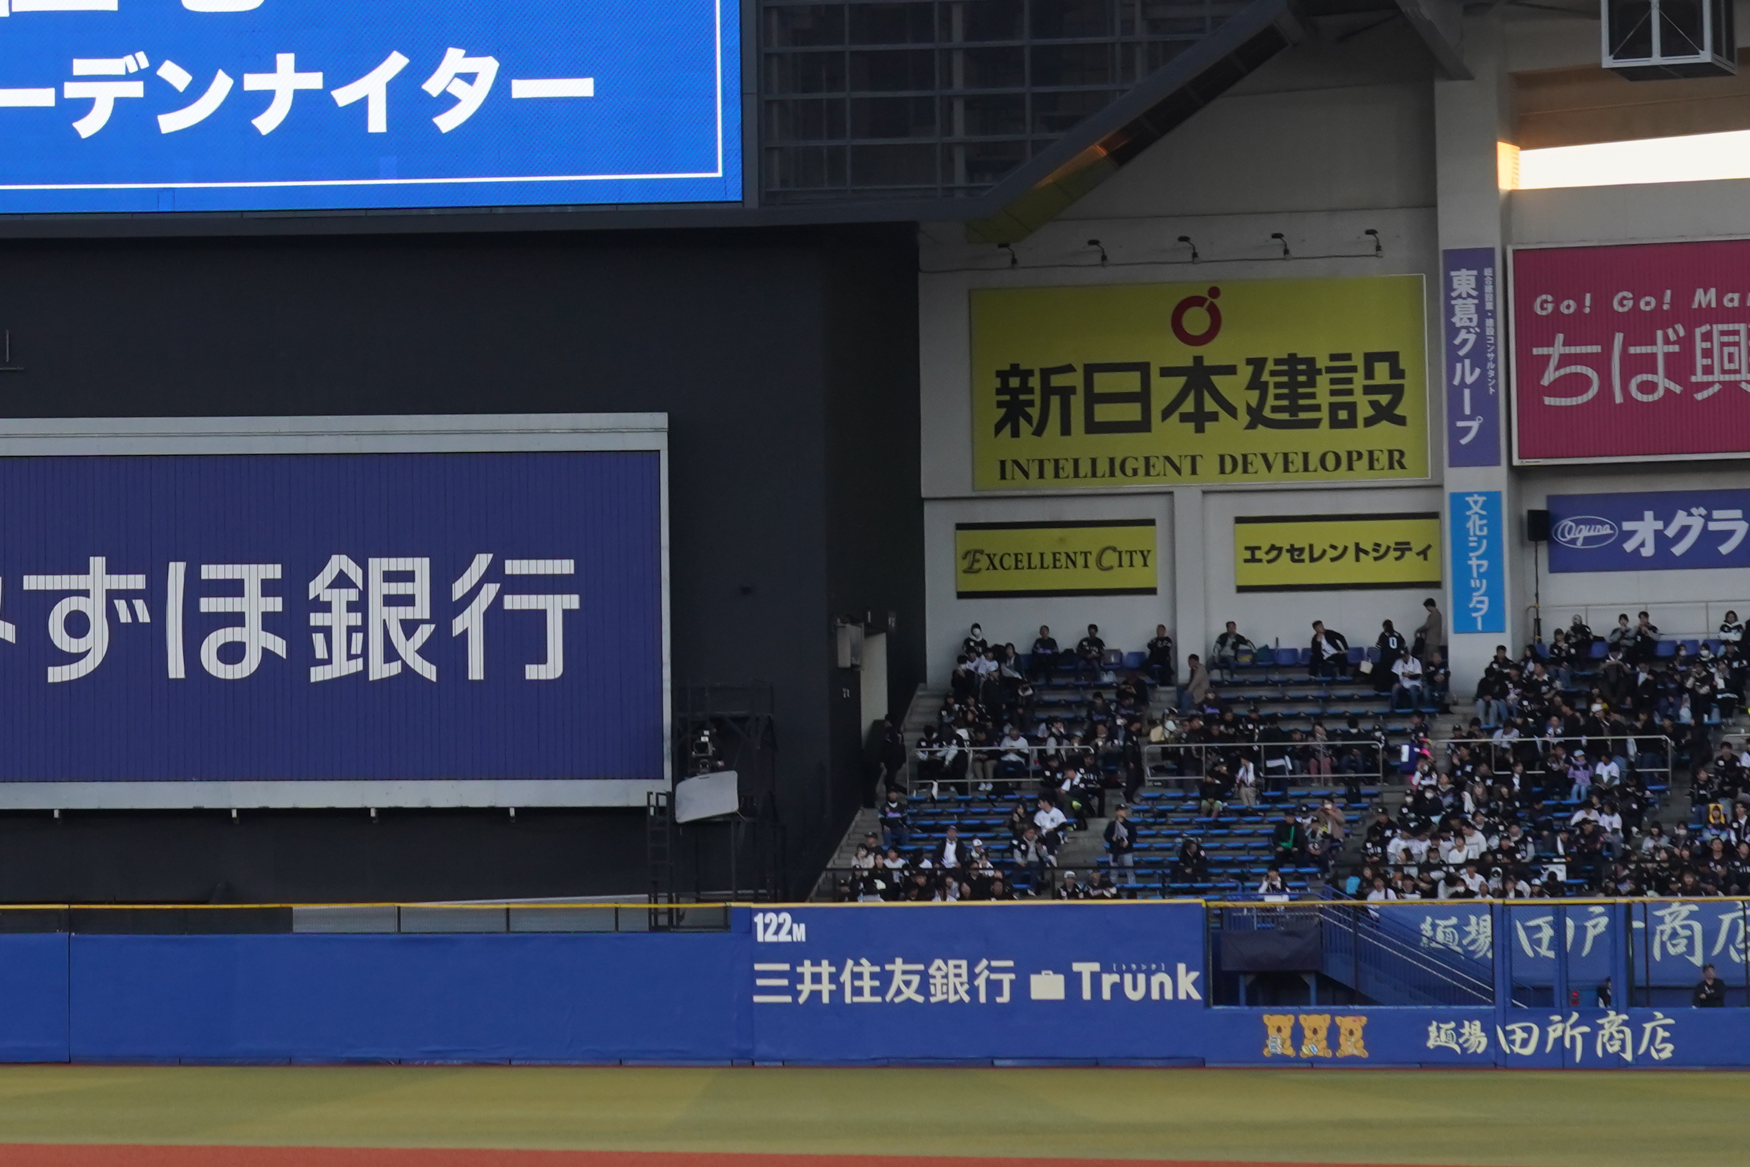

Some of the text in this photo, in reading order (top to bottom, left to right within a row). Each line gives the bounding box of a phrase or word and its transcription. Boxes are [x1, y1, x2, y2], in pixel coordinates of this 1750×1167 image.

[1534, 287, 1750, 316] Go! Go! Ma
[1532, 323, 1750, 407] ちば興
[993, 350, 1409, 439] 新日本建設
[997, 447, 1409, 482] INTELLIGENT DEVELOPER
[1621, 506, 1749, 557] オグラ
[962, 546, 1152, 575] EXCELLENT CITY
[1242, 539, 1433, 566] エクセレントシティ
[752, 957, 1016, 1005] 三井住友銀行
[1072, 961, 1203, 1002] Trunk
